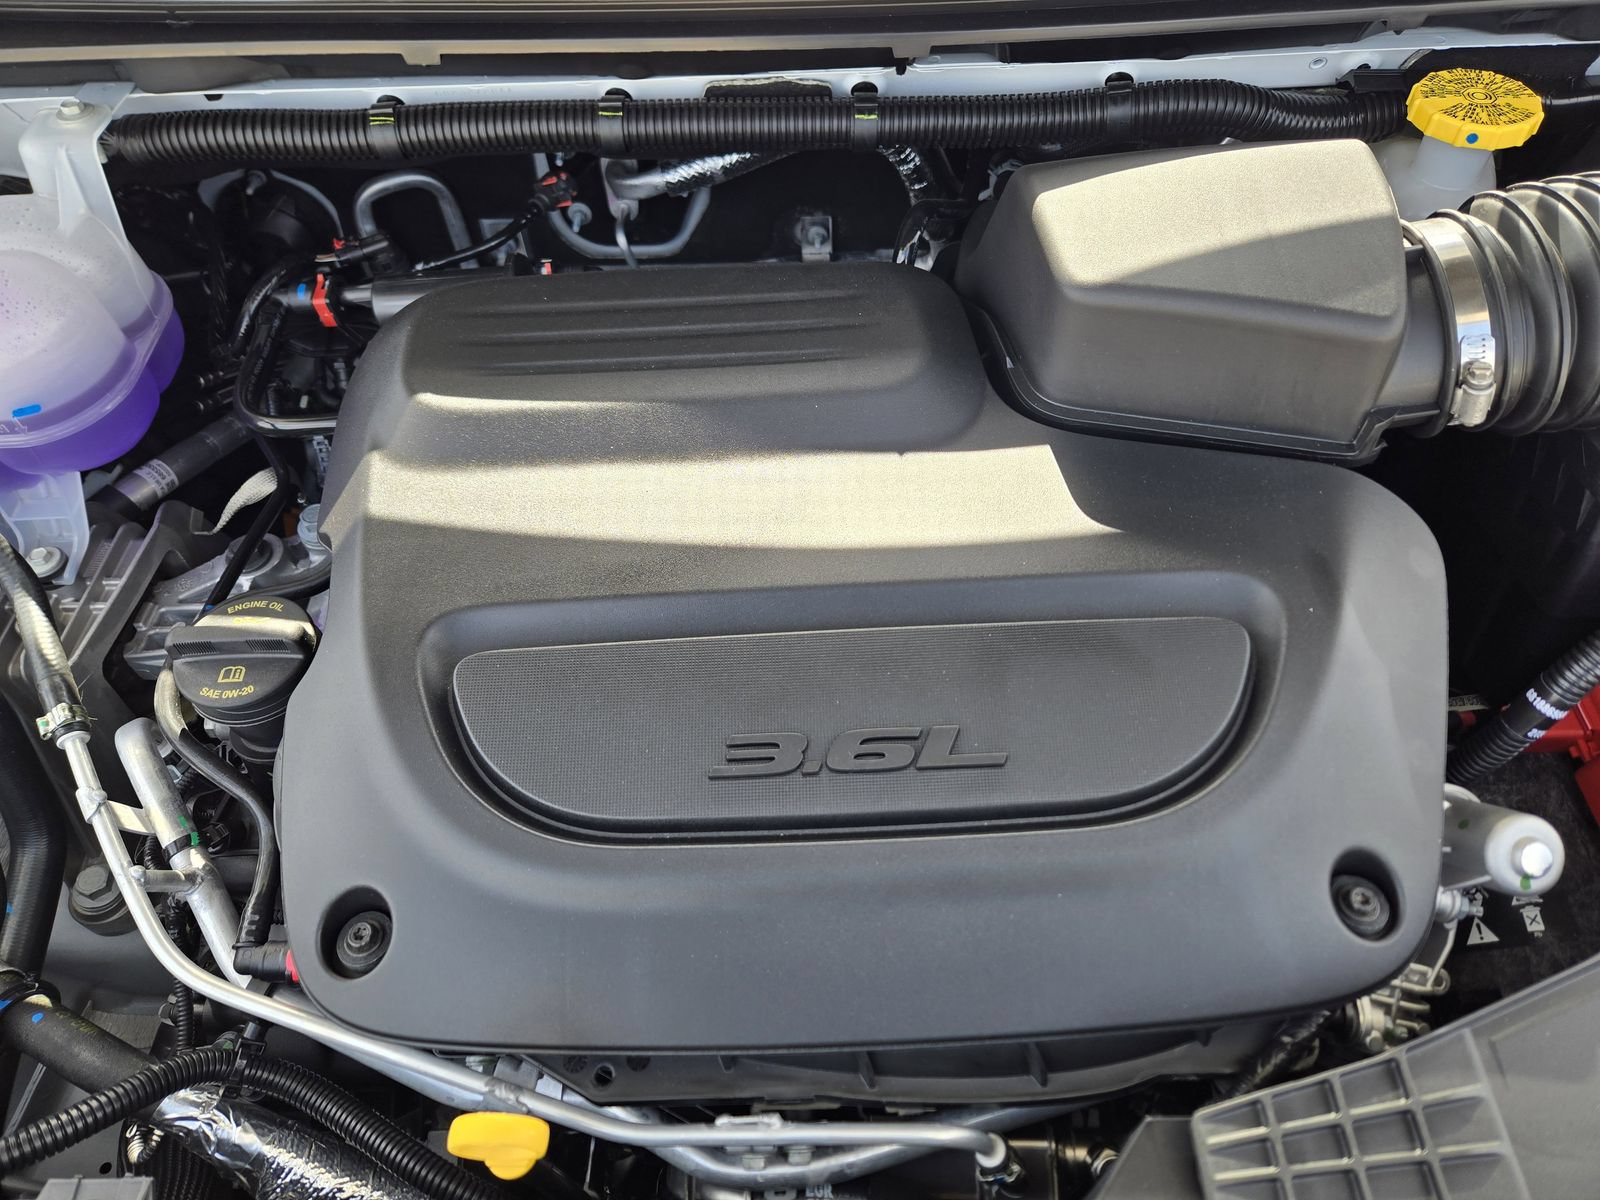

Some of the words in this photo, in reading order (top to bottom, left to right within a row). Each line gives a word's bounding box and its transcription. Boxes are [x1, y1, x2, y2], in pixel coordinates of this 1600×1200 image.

[227, 600, 268, 615] ENGINE
[268, 602, 285, 613] OIL
[199, 686, 221, 699] SAE
[222, 685, 255, 699] 0W-20
[708, 724, 1009, 780] 3.6L
